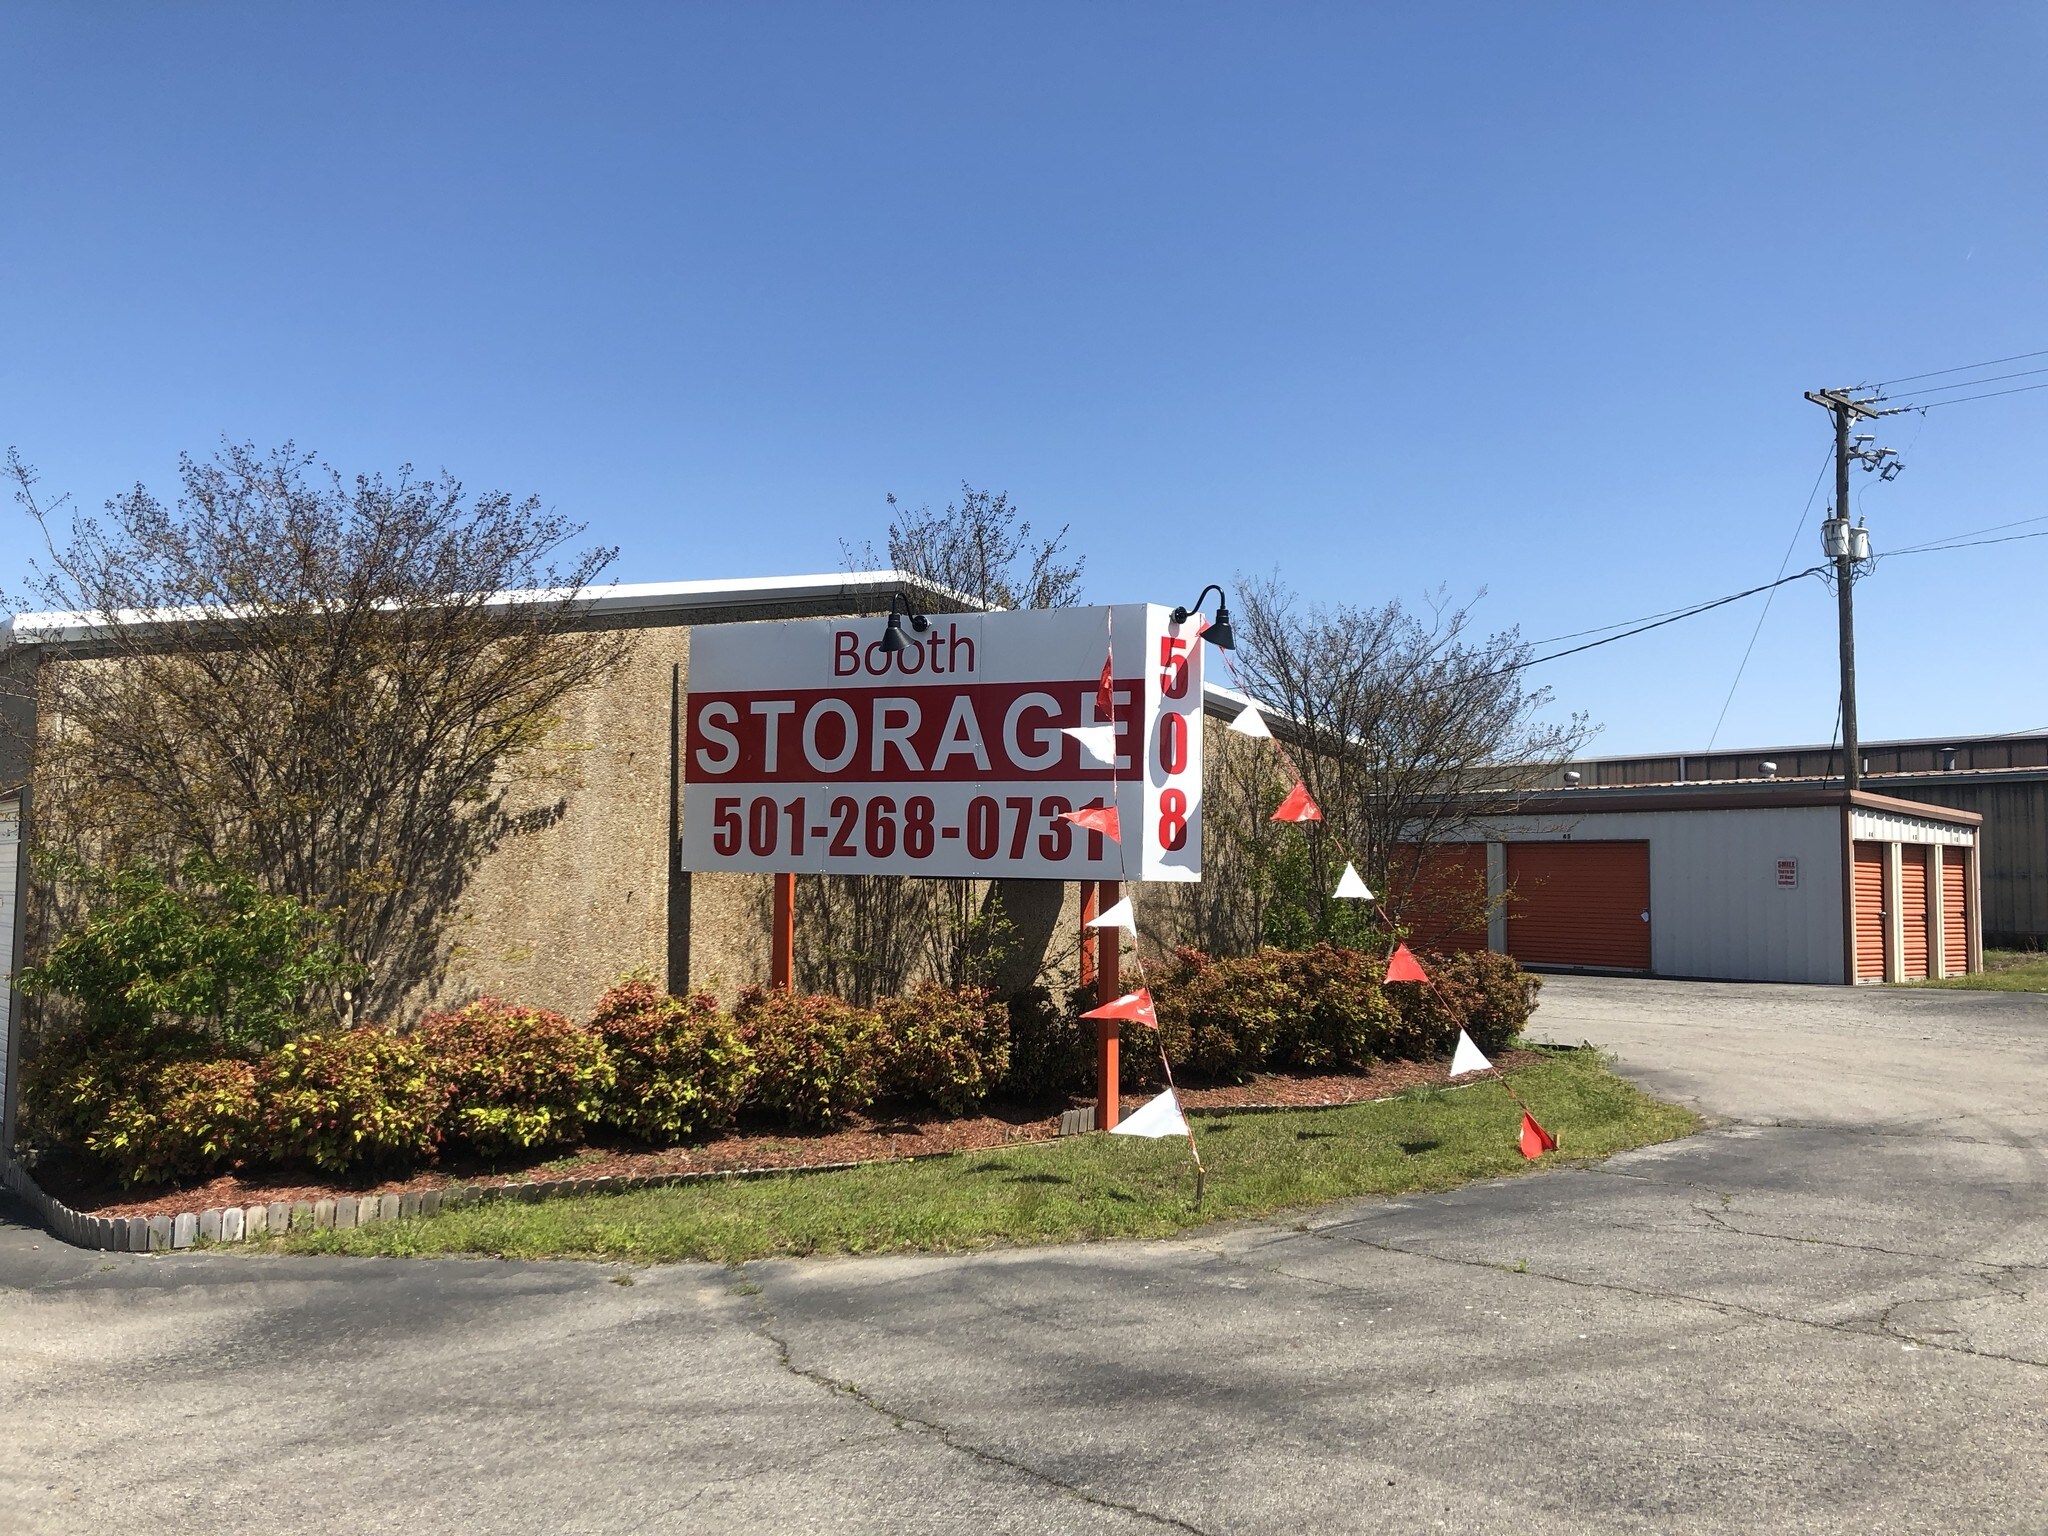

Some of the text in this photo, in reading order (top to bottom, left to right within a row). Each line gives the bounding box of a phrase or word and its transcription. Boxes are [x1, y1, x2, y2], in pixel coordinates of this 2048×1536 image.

[834, 623, 975, 676] Booth
[695, 691, 1132, 775] STORAGE
[1158, 634, 1189, 852] 508
[713, 794, 1105, 862] 501-268-0731
